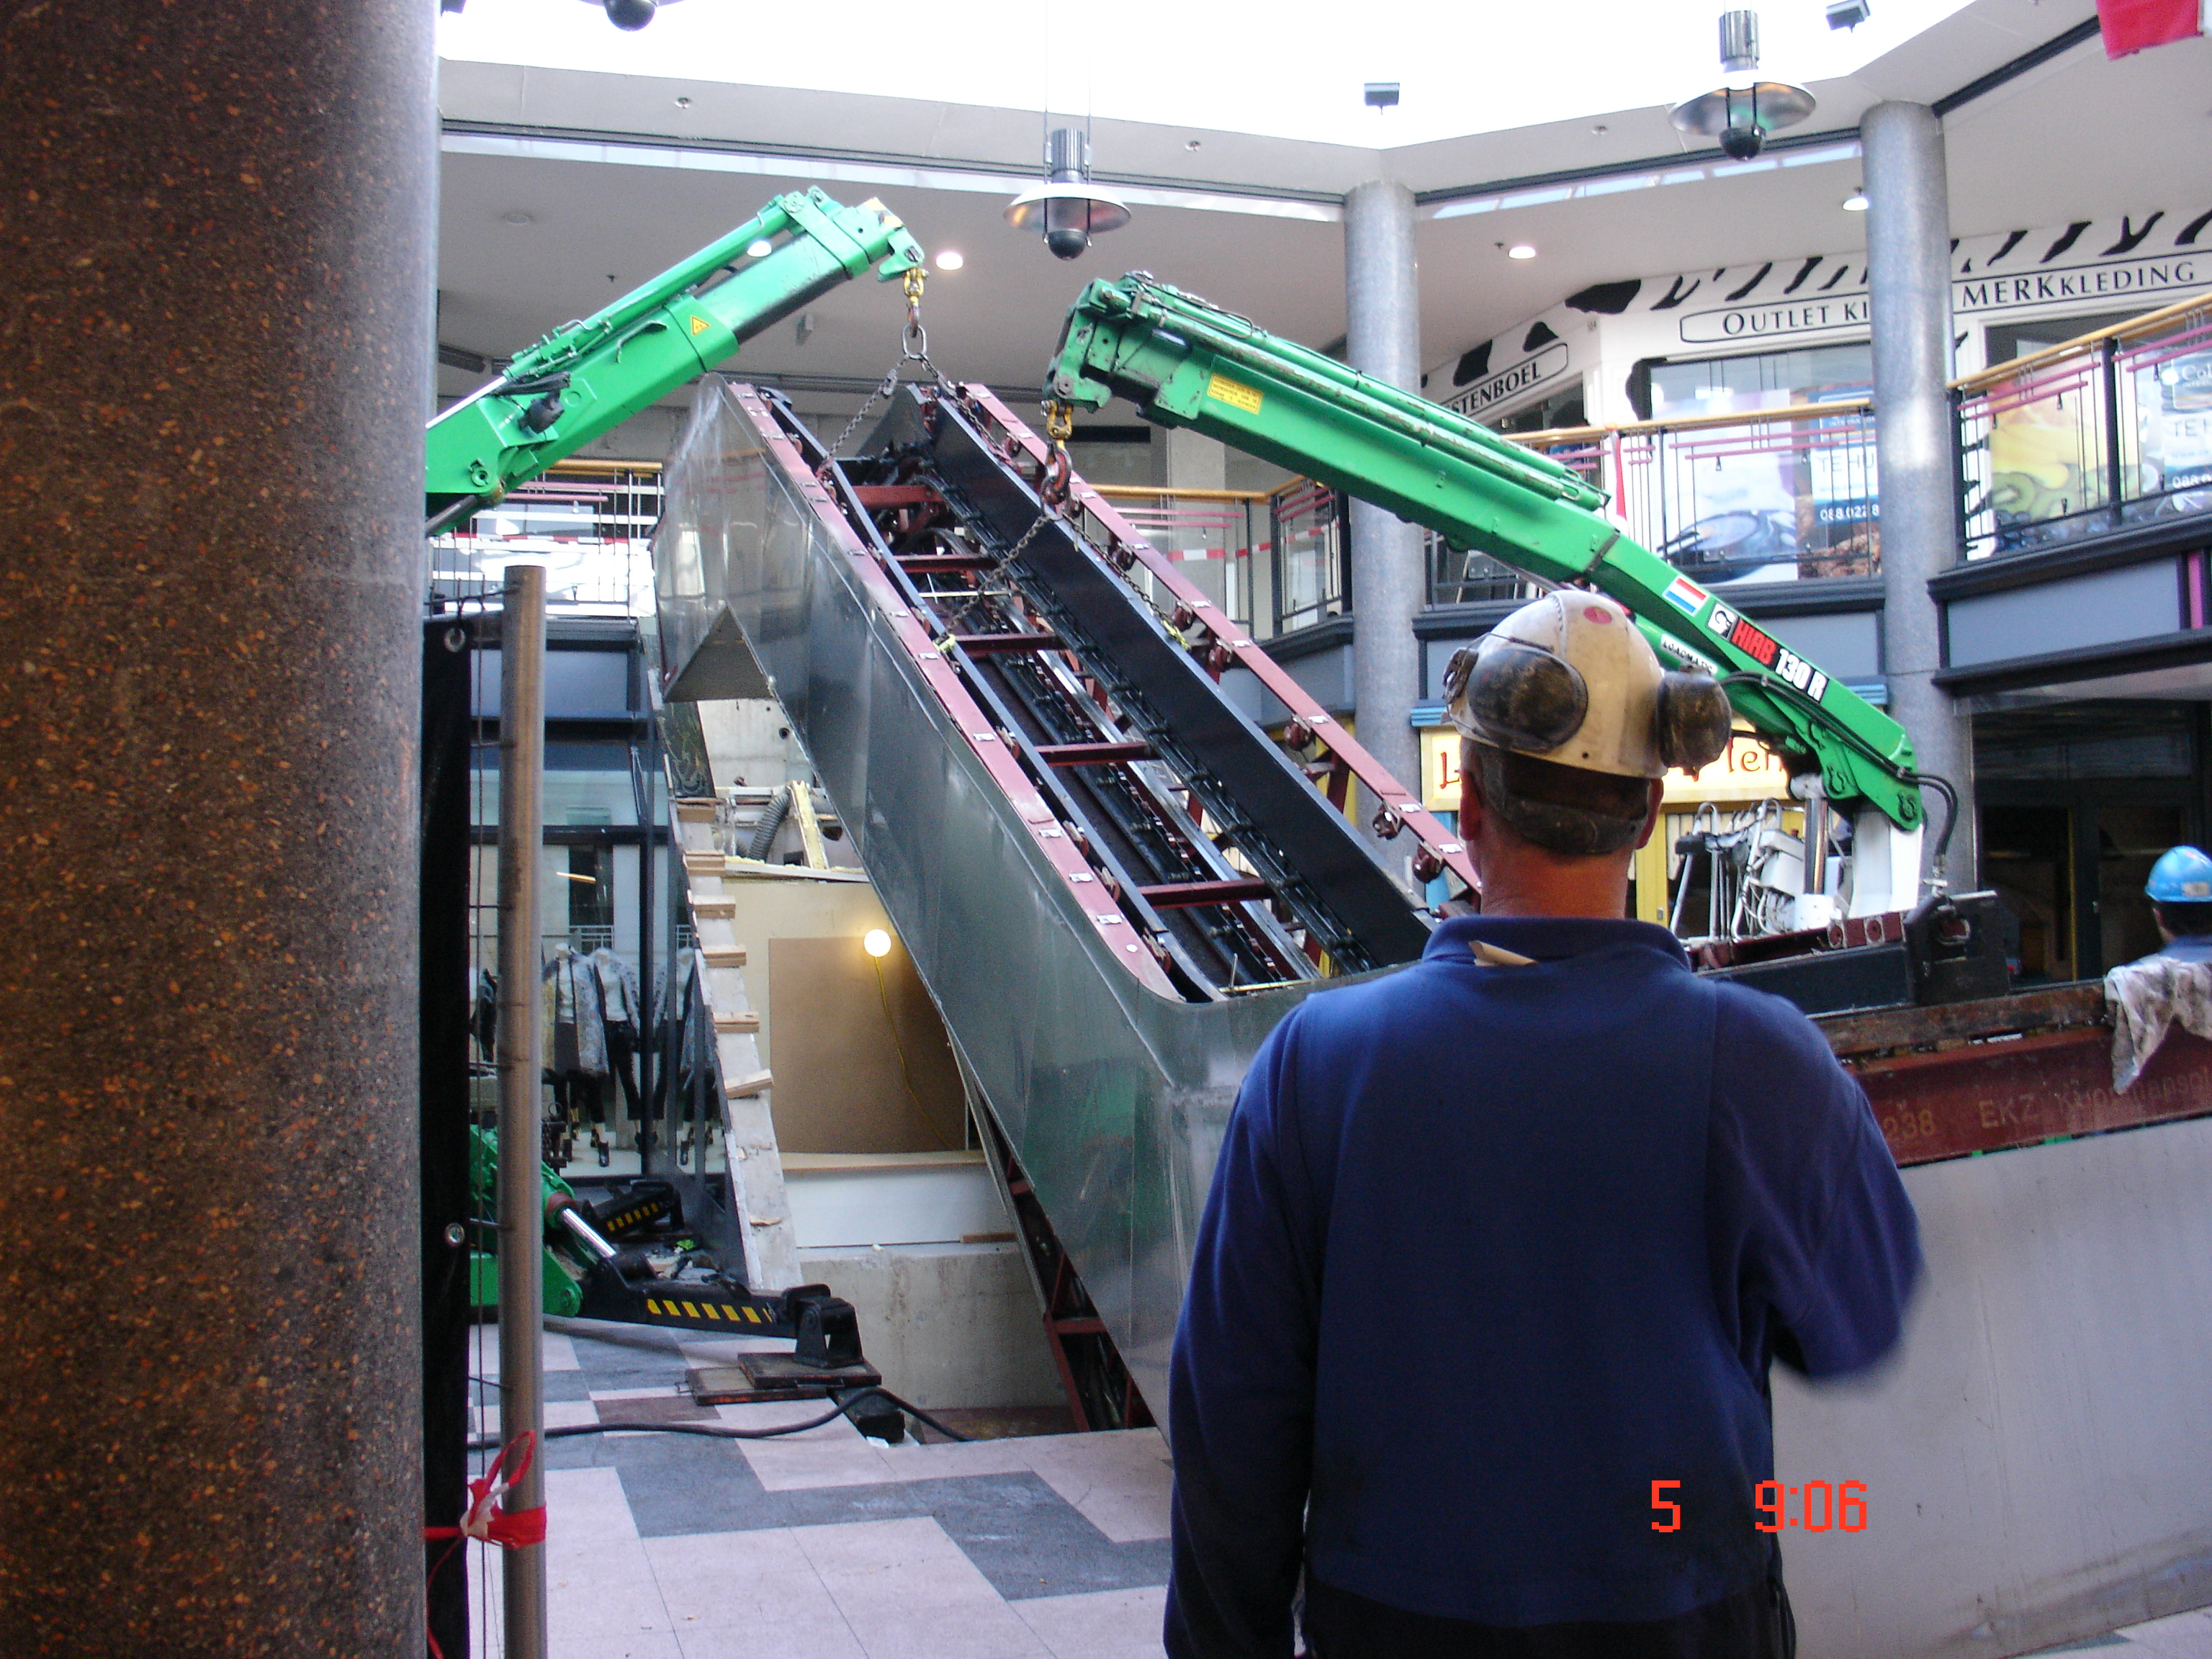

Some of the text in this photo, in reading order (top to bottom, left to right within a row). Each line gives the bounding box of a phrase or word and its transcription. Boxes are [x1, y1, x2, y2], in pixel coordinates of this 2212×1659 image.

[1722, 261, 2194, 335] OUTLET KI MERKKLEDING
[1447, 361, 1541, 415] STENBOEL
[1730, 619, 1828, 701] HIAB 130 R
[1978, 1094, 2038, 1130] EKZ
